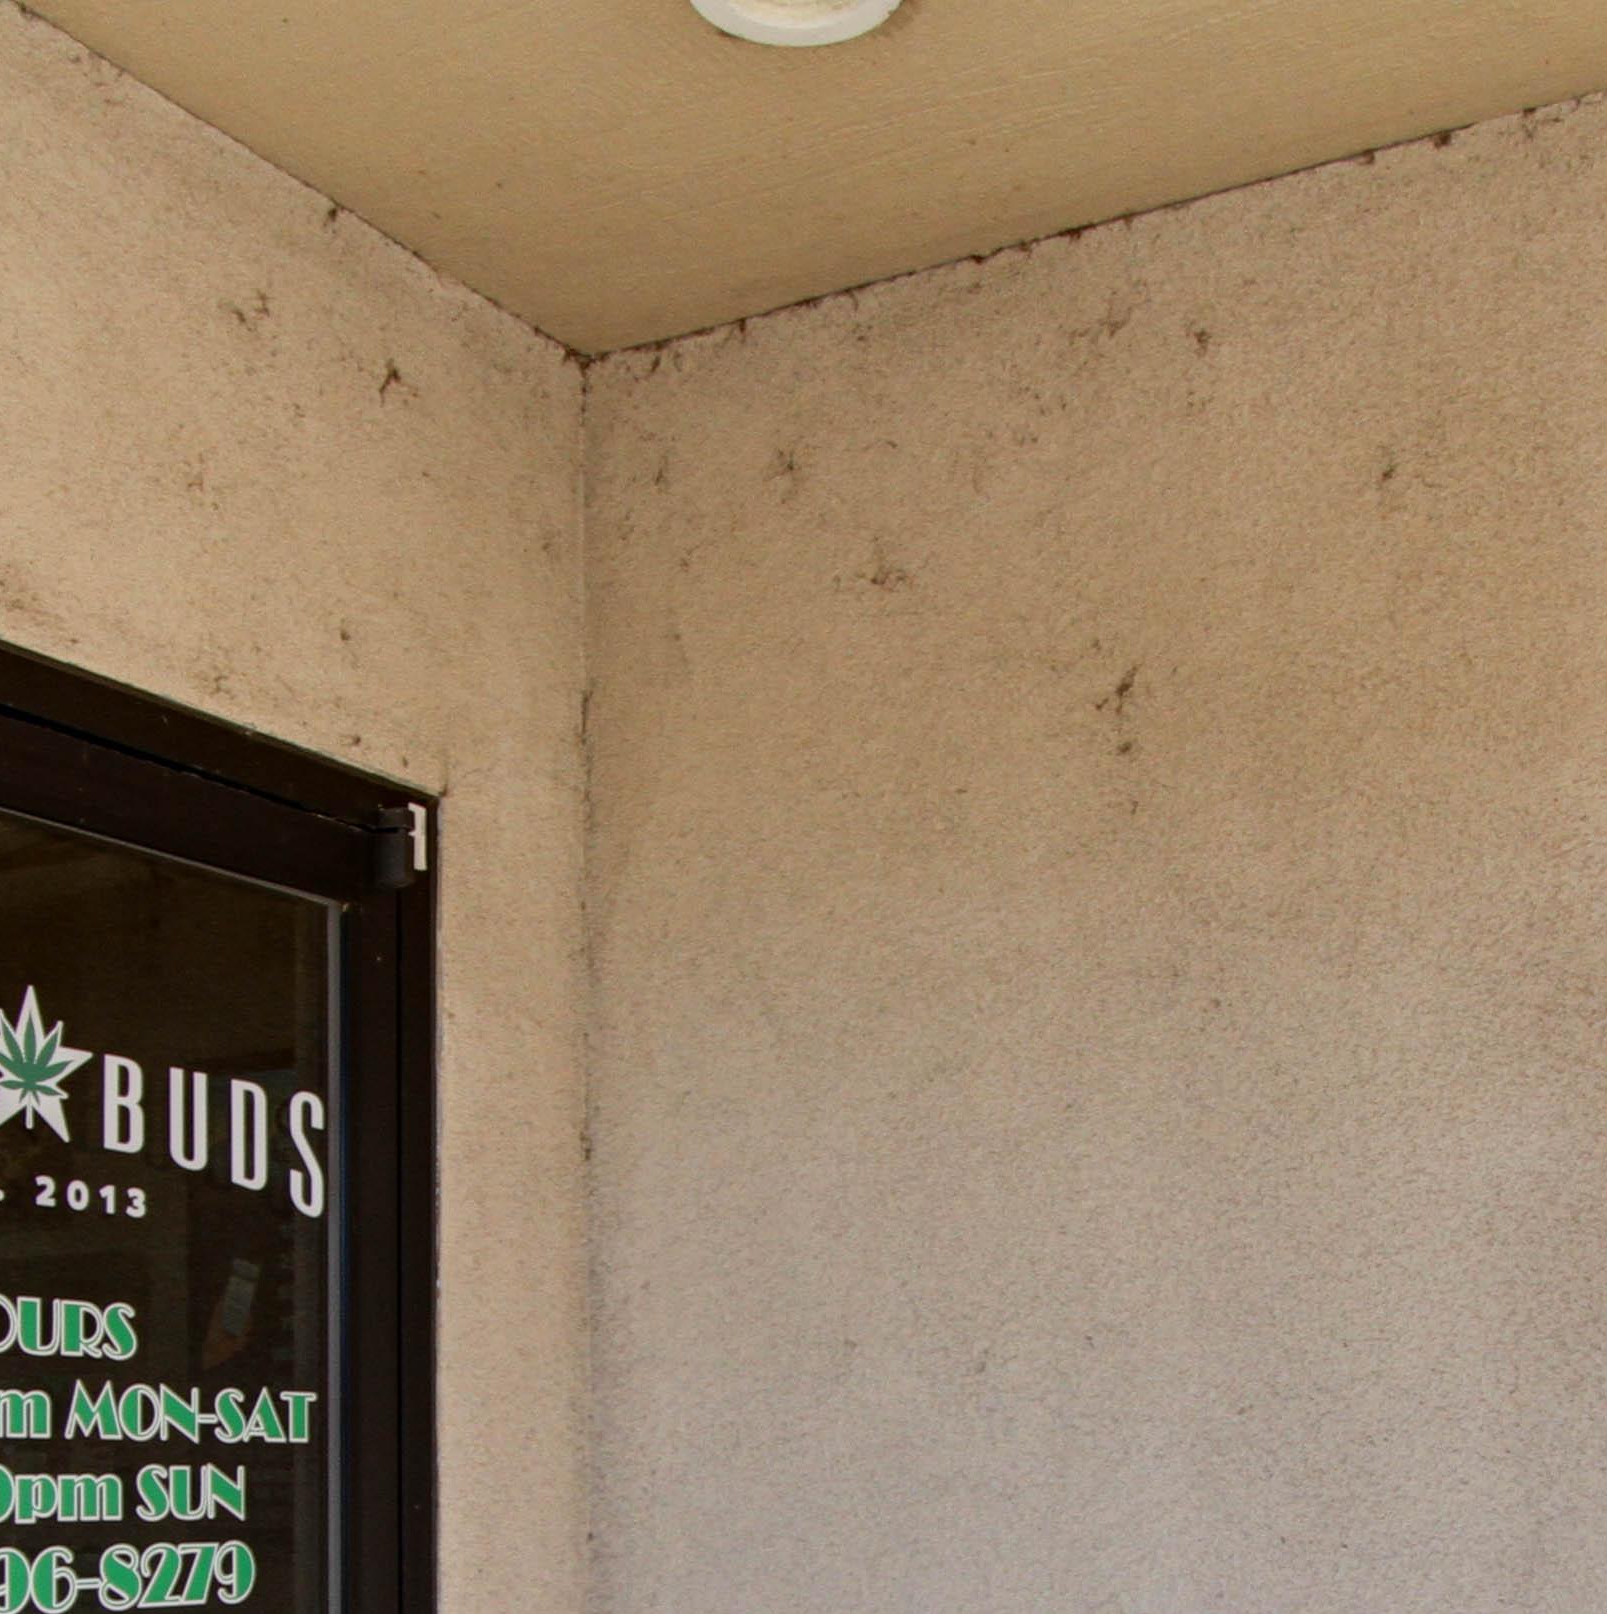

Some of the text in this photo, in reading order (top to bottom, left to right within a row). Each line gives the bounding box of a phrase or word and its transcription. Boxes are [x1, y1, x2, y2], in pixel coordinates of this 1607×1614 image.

[102, 1053, 326, 1218] BUDS
[35, 1175, 148, 1219] 2013
[64, 1380, 316, 1443] MON-SAT
[136, 1463, 246, 1521] SUN
